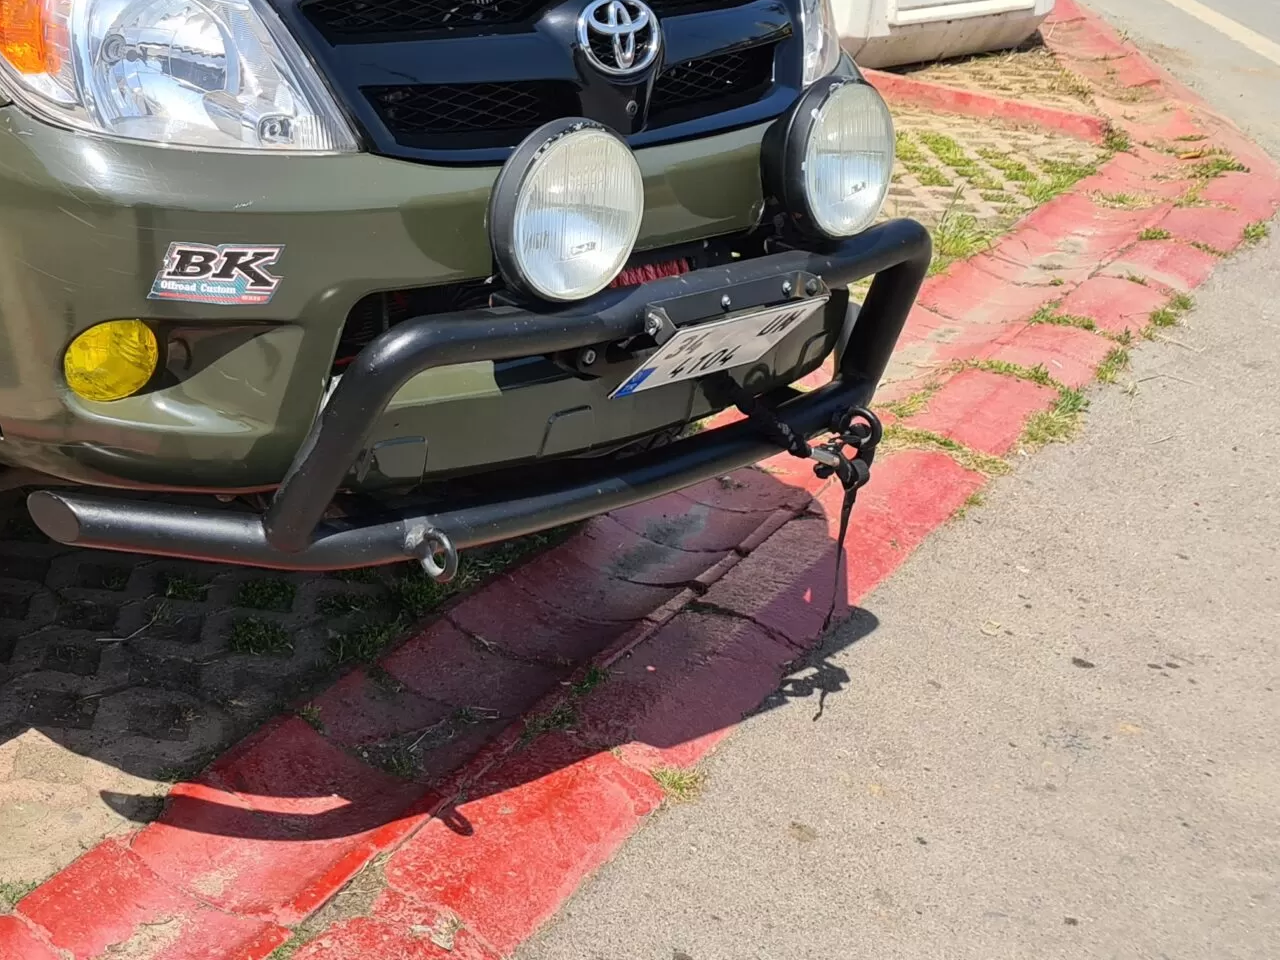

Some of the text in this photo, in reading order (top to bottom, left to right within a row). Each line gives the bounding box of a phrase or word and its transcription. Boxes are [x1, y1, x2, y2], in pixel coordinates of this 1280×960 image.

[166, 248, 277, 288] BK
[161, 280, 236, 294] Offroad Custom
[664, 332, 710, 359] 34
[670, 345, 741, 378] 4104
